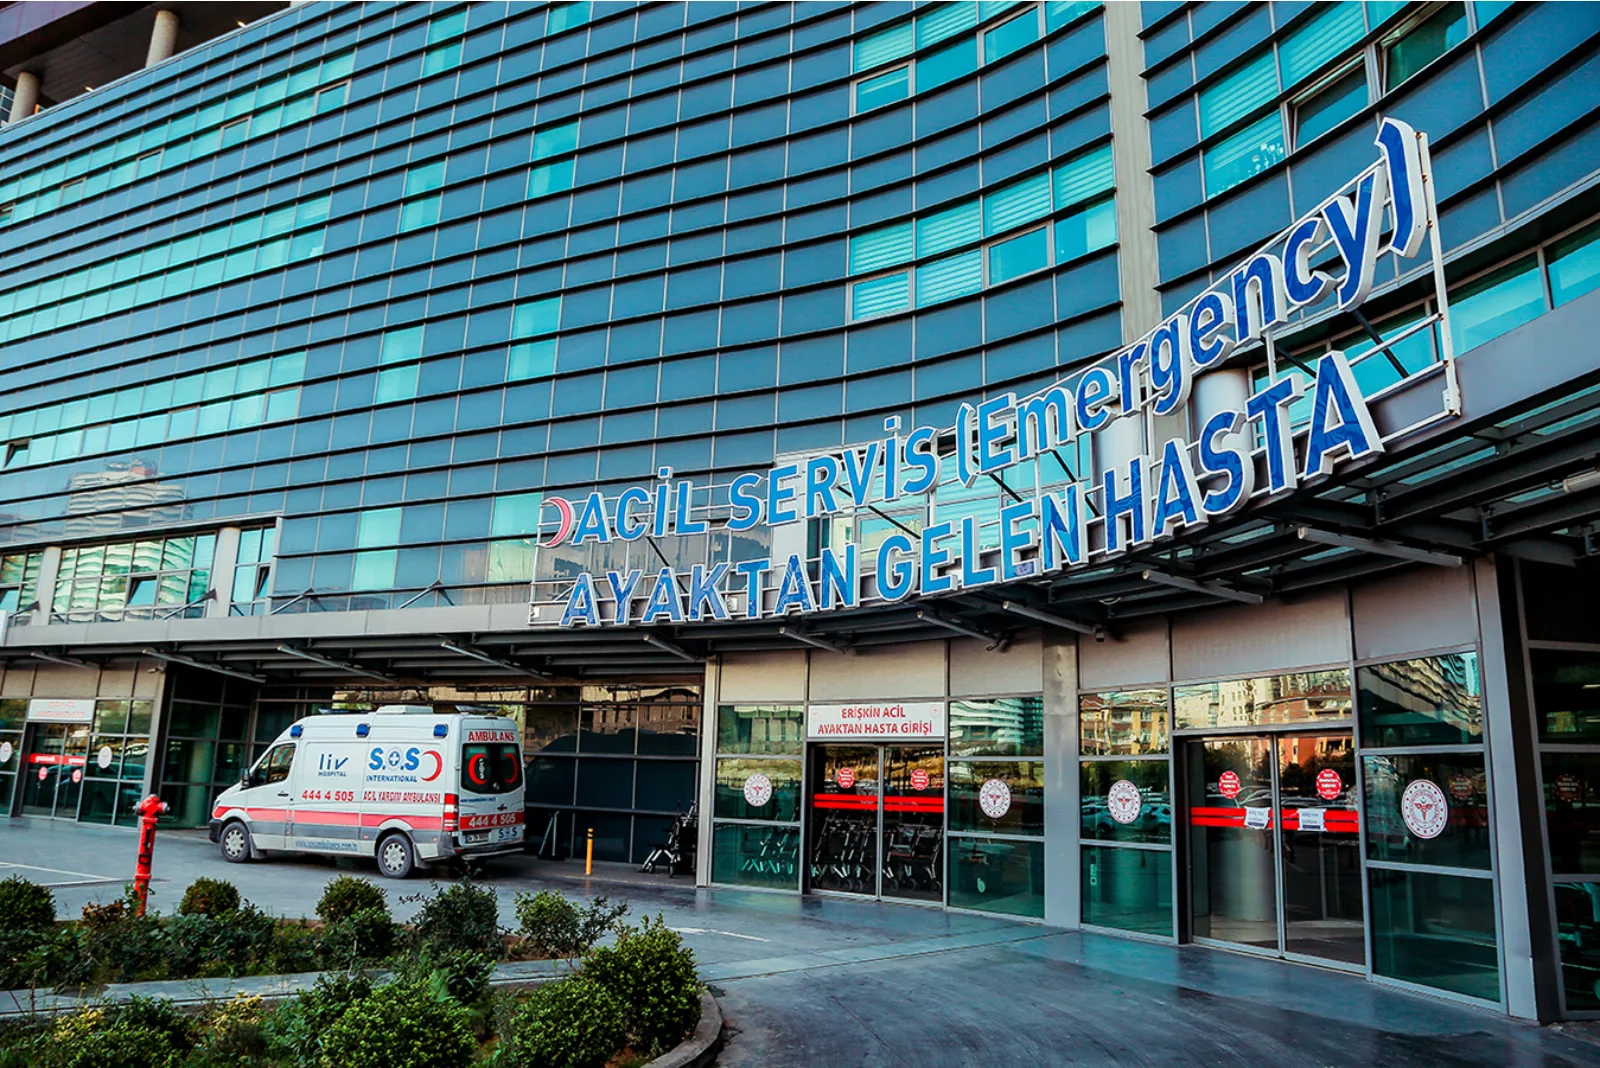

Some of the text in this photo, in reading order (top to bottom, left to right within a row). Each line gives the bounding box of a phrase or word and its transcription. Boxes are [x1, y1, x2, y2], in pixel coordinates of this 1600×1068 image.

[572, 117, 1428, 546] ACİL SERVİS (Emergency)
[559, 350, 1384, 628] AYAKTAN GELEN HASTA
[841, 704, 906, 720] ERİŞKİN ACİL
[817, 720, 933, 735] AYAKTAN HASTA GİRİŞİ
[468, 731, 515, 742] AMBULANS
[366, 774, 418, 783] INTERNATIONAL
[302, 789, 354, 802] 444 4 505
[469, 816, 489, 827] 444
[491, 815, 498, 825] 4
